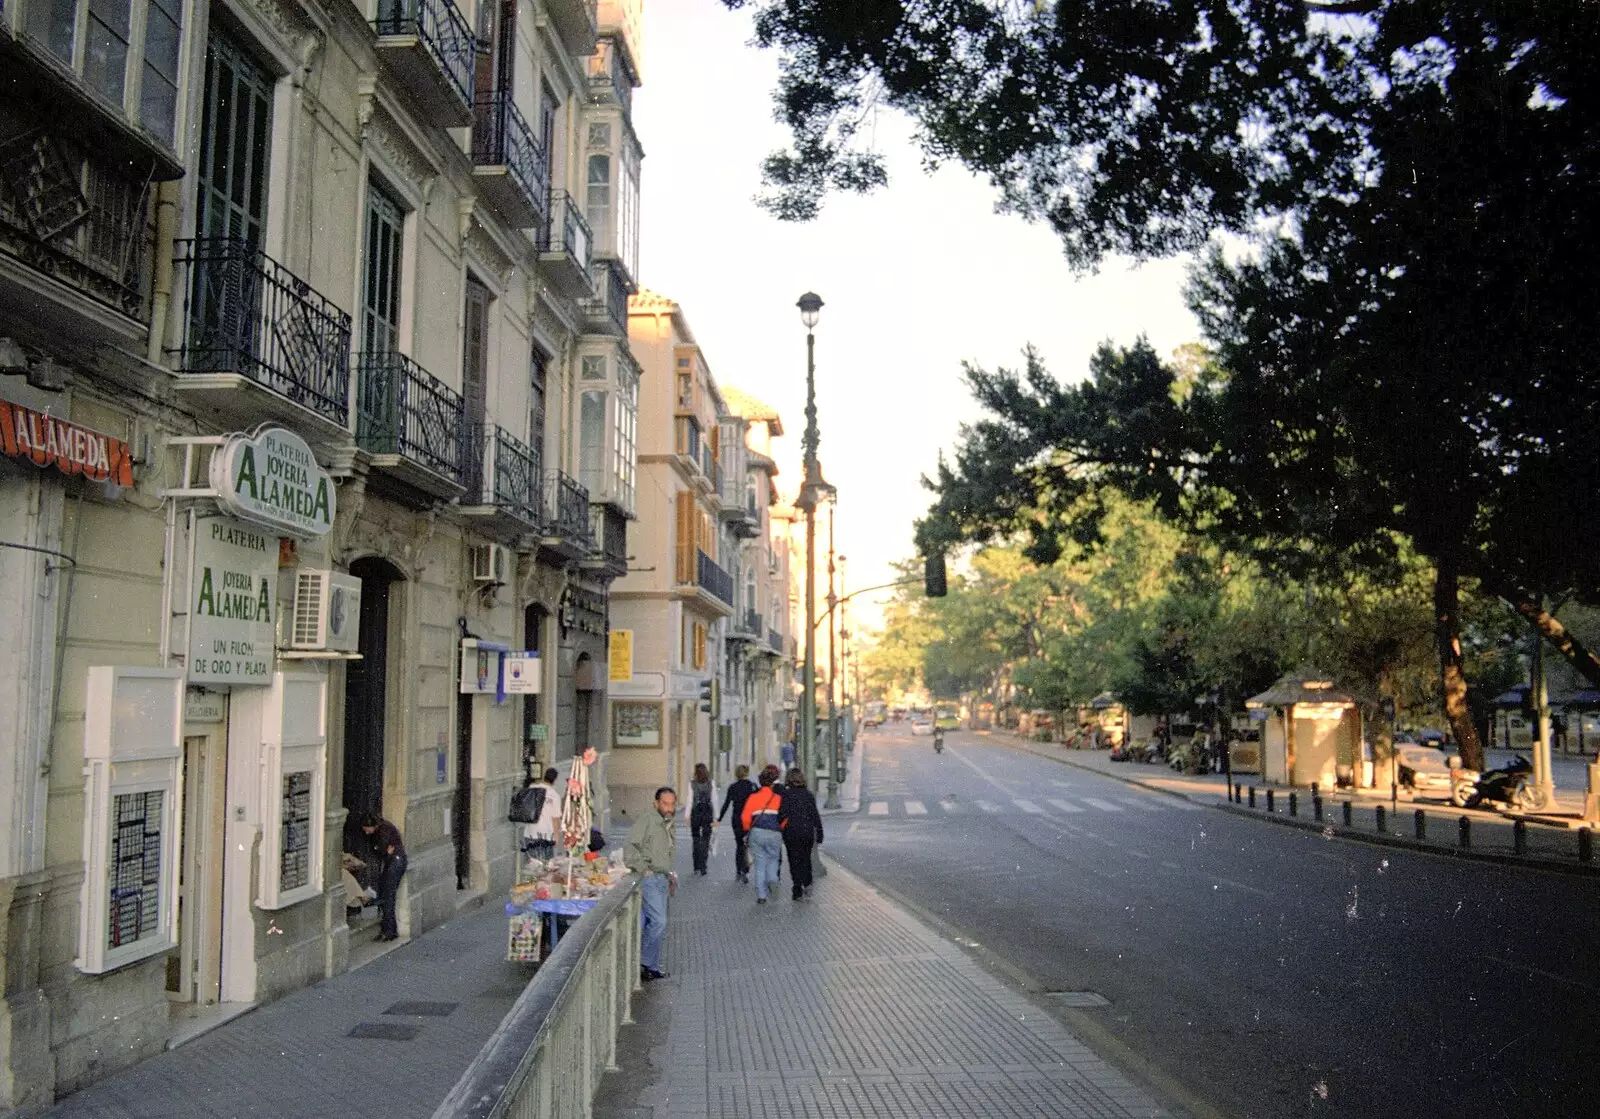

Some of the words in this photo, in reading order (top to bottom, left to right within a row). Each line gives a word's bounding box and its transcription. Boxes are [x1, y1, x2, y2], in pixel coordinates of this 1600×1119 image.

[16, 410, 110, 471] ALAMEDA
[266, 436, 310, 467] PLATERIA
[235, 444, 330, 525] ALAMEDA
[266, 454, 308, 488] JOYERIA
[212, 523, 266, 552] PLATERIA
[197, 566, 271, 623] ALAMEDA
[222, 570, 252, 592] JOYERIA
[213, 640, 226, 654] UN
[230, 641, 254, 656] FILON
[195, 659, 206, 673] DE
[212, 660, 231, 674] ORO
[236, 661, 241, 675] Y
[245, 661, 267, 675] PLATA
